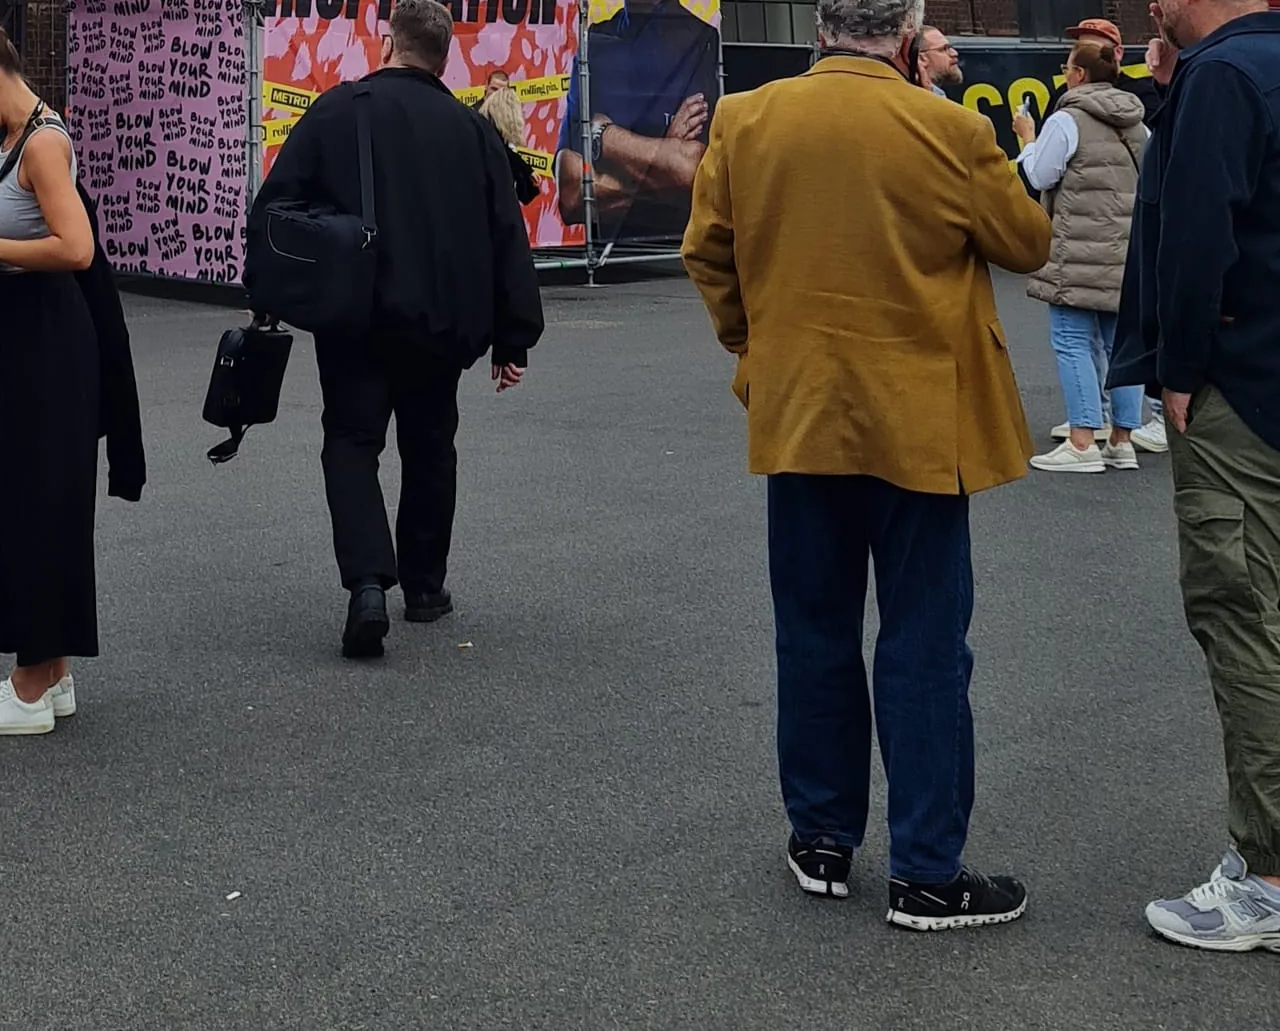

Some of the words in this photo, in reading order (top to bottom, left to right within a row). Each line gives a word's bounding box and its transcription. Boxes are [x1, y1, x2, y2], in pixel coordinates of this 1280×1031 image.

[162, 9, 189, 21] MIND
[194, 11, 223, 25] YOUR
[110, 22, 138, 40] BLOW
[194, 22, 222, 37] MIND
[109, 36, 136, 52] YOUR
[171, 36, 213, 60] BLOW
[218, 41, 245, 58] BLO
[109, 50, 134, 64] MIND
[138, 60, 165, 74] BLOW
[169, 58, 213, 81] YOUR
[138, 75, 165, 88] YOUR
[168, 75, 211, 98] MIND
[139, 86, 165, 100] MIND
[217, 90, 243, 107] BLOW
[272, 89, 309, 108] METRO
[116, 108, 154, 130] BLOW
[190, 112, 217, 127] BLOW
[219, 104, 245, 120] YOUR
[222, 114, 246, 130] MIND
[190, 124, 216, 139] YOUR
[116, 131, 156, 153] YOUR
[189, 136, 214, 150] MIND
[118, 149, 156, 171] MIND
[166, 150, 212, 176] BLOW
[136, 177, 162, 192] BLOW
[166, 171, 210, 196] YOUR
[215, 181, 241, 197] BLOW
[102, 191, 130, 206] BLOW
[136, 190, 161, 203] YOUR
[166, 191, 208, 215] MIND
[214, 193, 240, 209] YOUR
[103, 206, 133, 221] YOUR
[136, 202, 160, 214] MIND
[213, 206, 239, 219] MIND
[106, 218, 133, 234] MIND
[150, 213, 179, 235] BLOW
[192, 220, 235, 242] BLOW
[106, 236, 149, 258] BLOW
[154, 228, 185, 251] YOUR
[161, 241, 187, 262] MIND
[194, 245, 238, 265] YOUR
[196, 262, 238, 282] MIND
